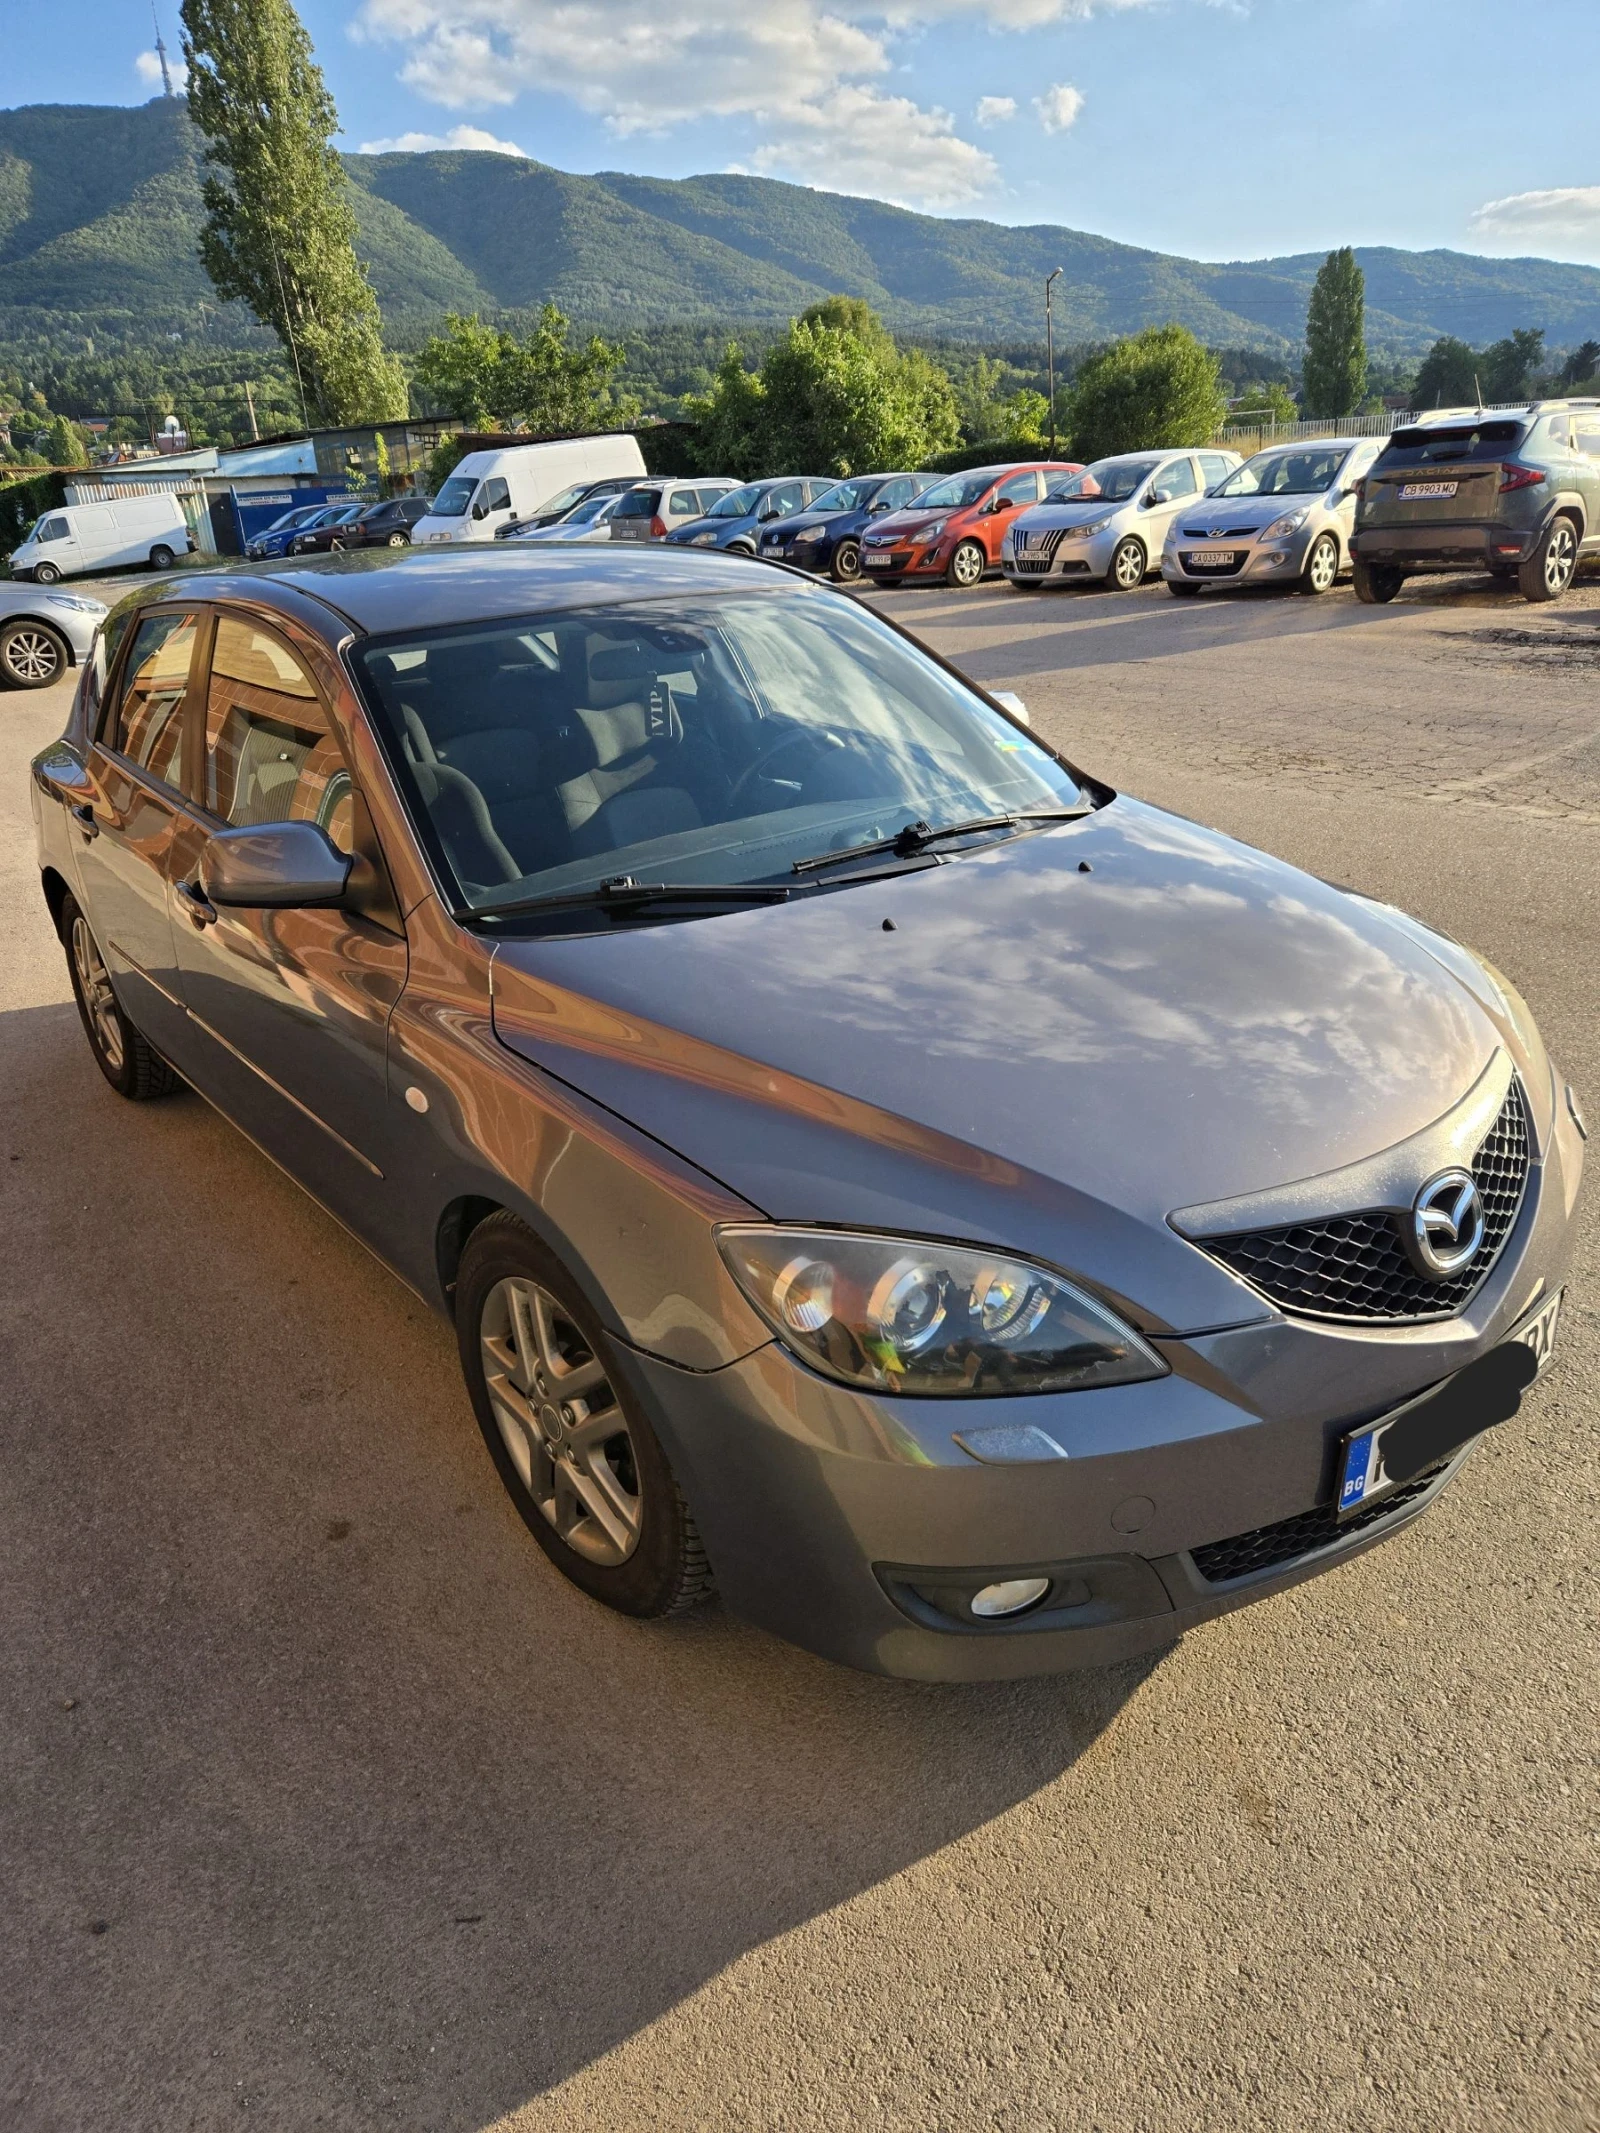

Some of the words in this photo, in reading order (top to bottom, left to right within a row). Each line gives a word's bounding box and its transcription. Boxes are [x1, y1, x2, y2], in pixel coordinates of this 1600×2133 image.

[1404, 485, 1417, 496] CB
[1418, 484, 1441, 495] 9903
[1192, 553, 1202, 563] CA
[1202, 553, 1221, 563] 0337
[1222, 553, 1233, 562] TM
[650, 691, 664, 729] VIP
[1344, 1475, 1364, 1497] BG
